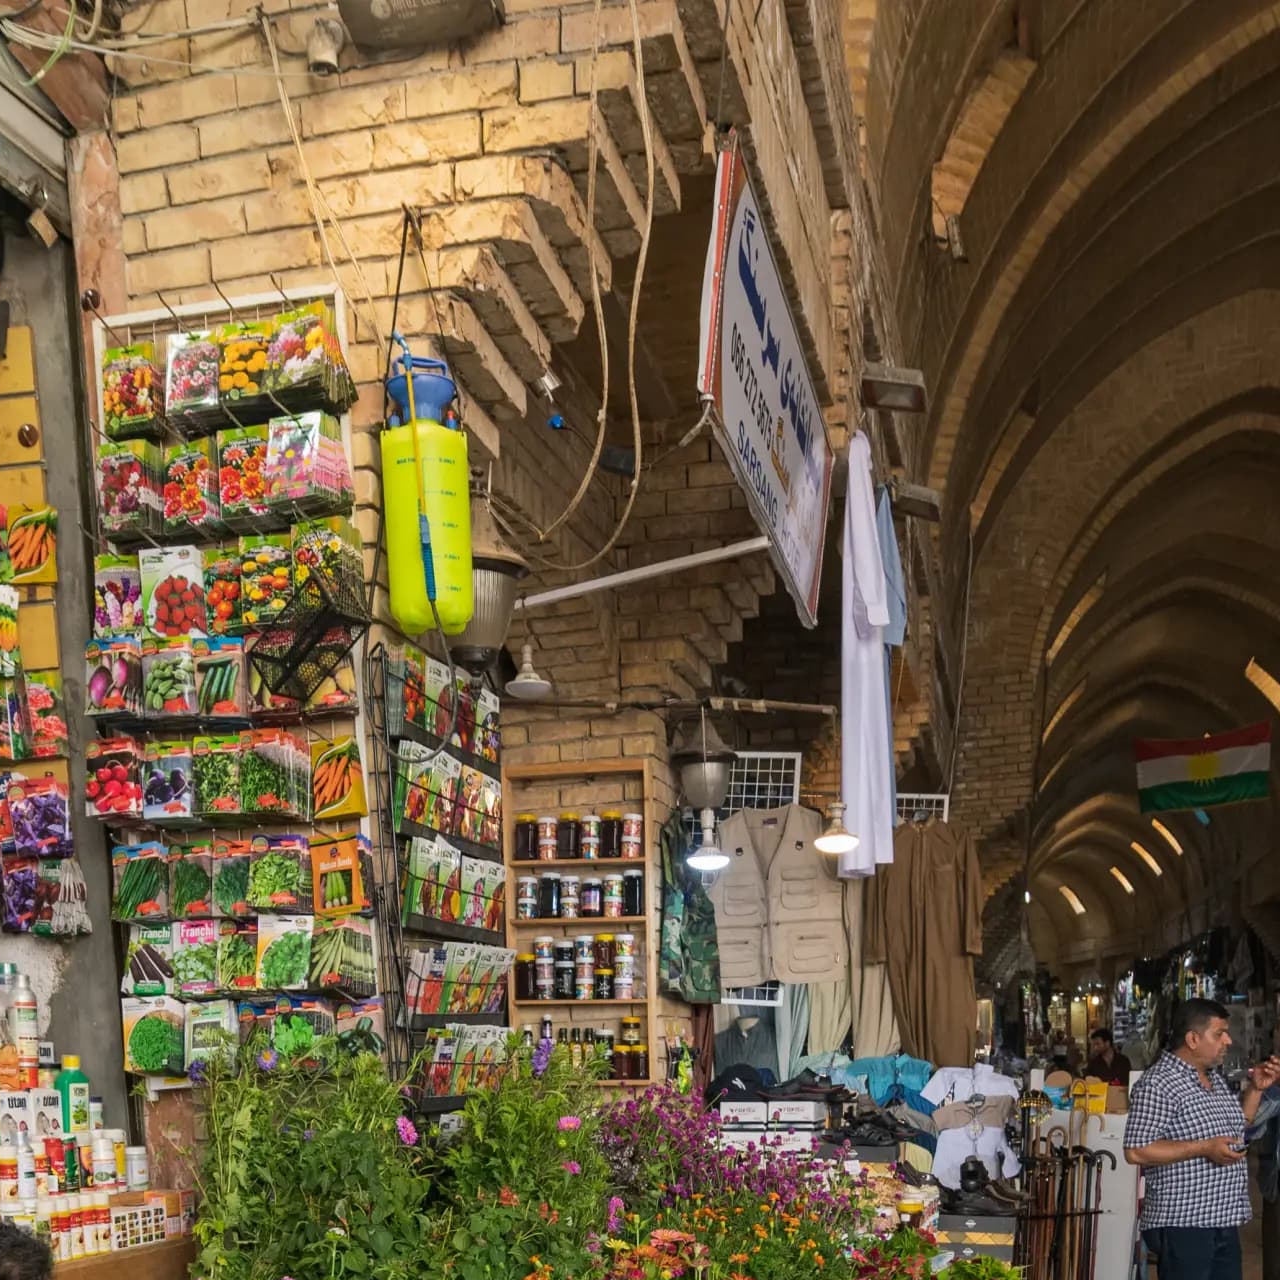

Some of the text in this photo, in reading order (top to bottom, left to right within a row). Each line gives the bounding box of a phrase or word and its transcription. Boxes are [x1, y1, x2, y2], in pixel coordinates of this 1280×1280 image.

[731, 321, 774, 451] 066 272 5675
[738, 420, 801, 582] SARSANG HOTEL
[180, 922, 215, 939] Franchi
[8, 1097, 27, 1110] titan
